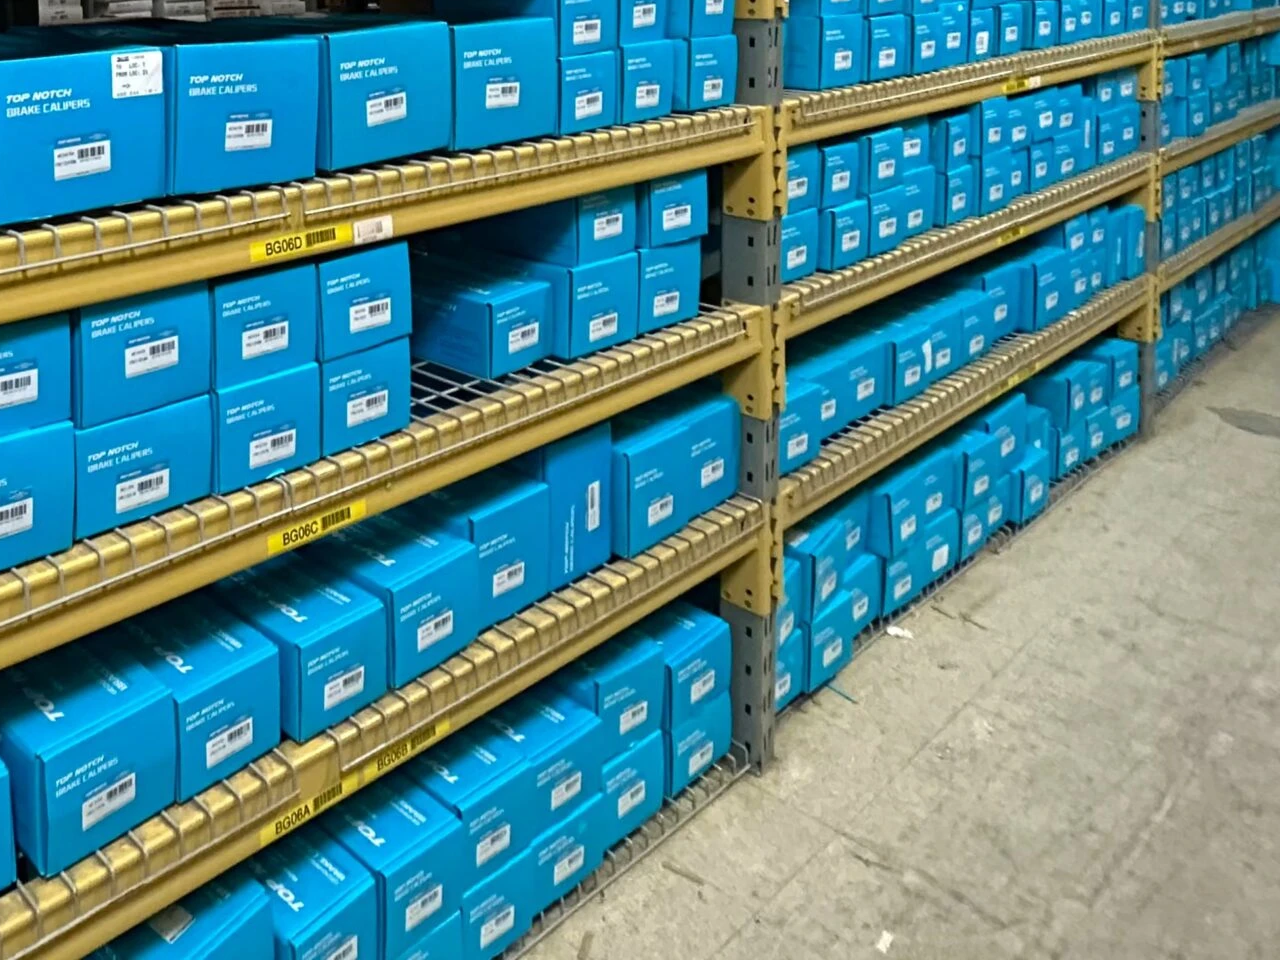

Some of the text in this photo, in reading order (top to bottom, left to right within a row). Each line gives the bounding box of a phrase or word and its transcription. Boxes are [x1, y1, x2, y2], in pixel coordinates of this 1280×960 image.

[340, 58, 385, 70] TOP NOTCH
[190, 74, 243, 84] TOP NOTCH
[340, 66, 398, 81] BRAKE CALIPERS
[7, 89, 72, 104] TOP NOTCH
[189, 84, 257, 96] BRAKE CALIPERS
[7, 99, 90, 117] BRAKE CALIPERS
[265, 236, 303, 256] BG06D
[92, 311, 140, 328] TOP NOTCH
[92, 318, 154, 338] BRAKE CALIPERS
[88, 442, 138, 462] TOP NOTCH
[88, 448, 152, 472] BRAKE CALIPERS
[282, 520, 318, 546] BG06C
[275, 804, 310, 835] BG06A
